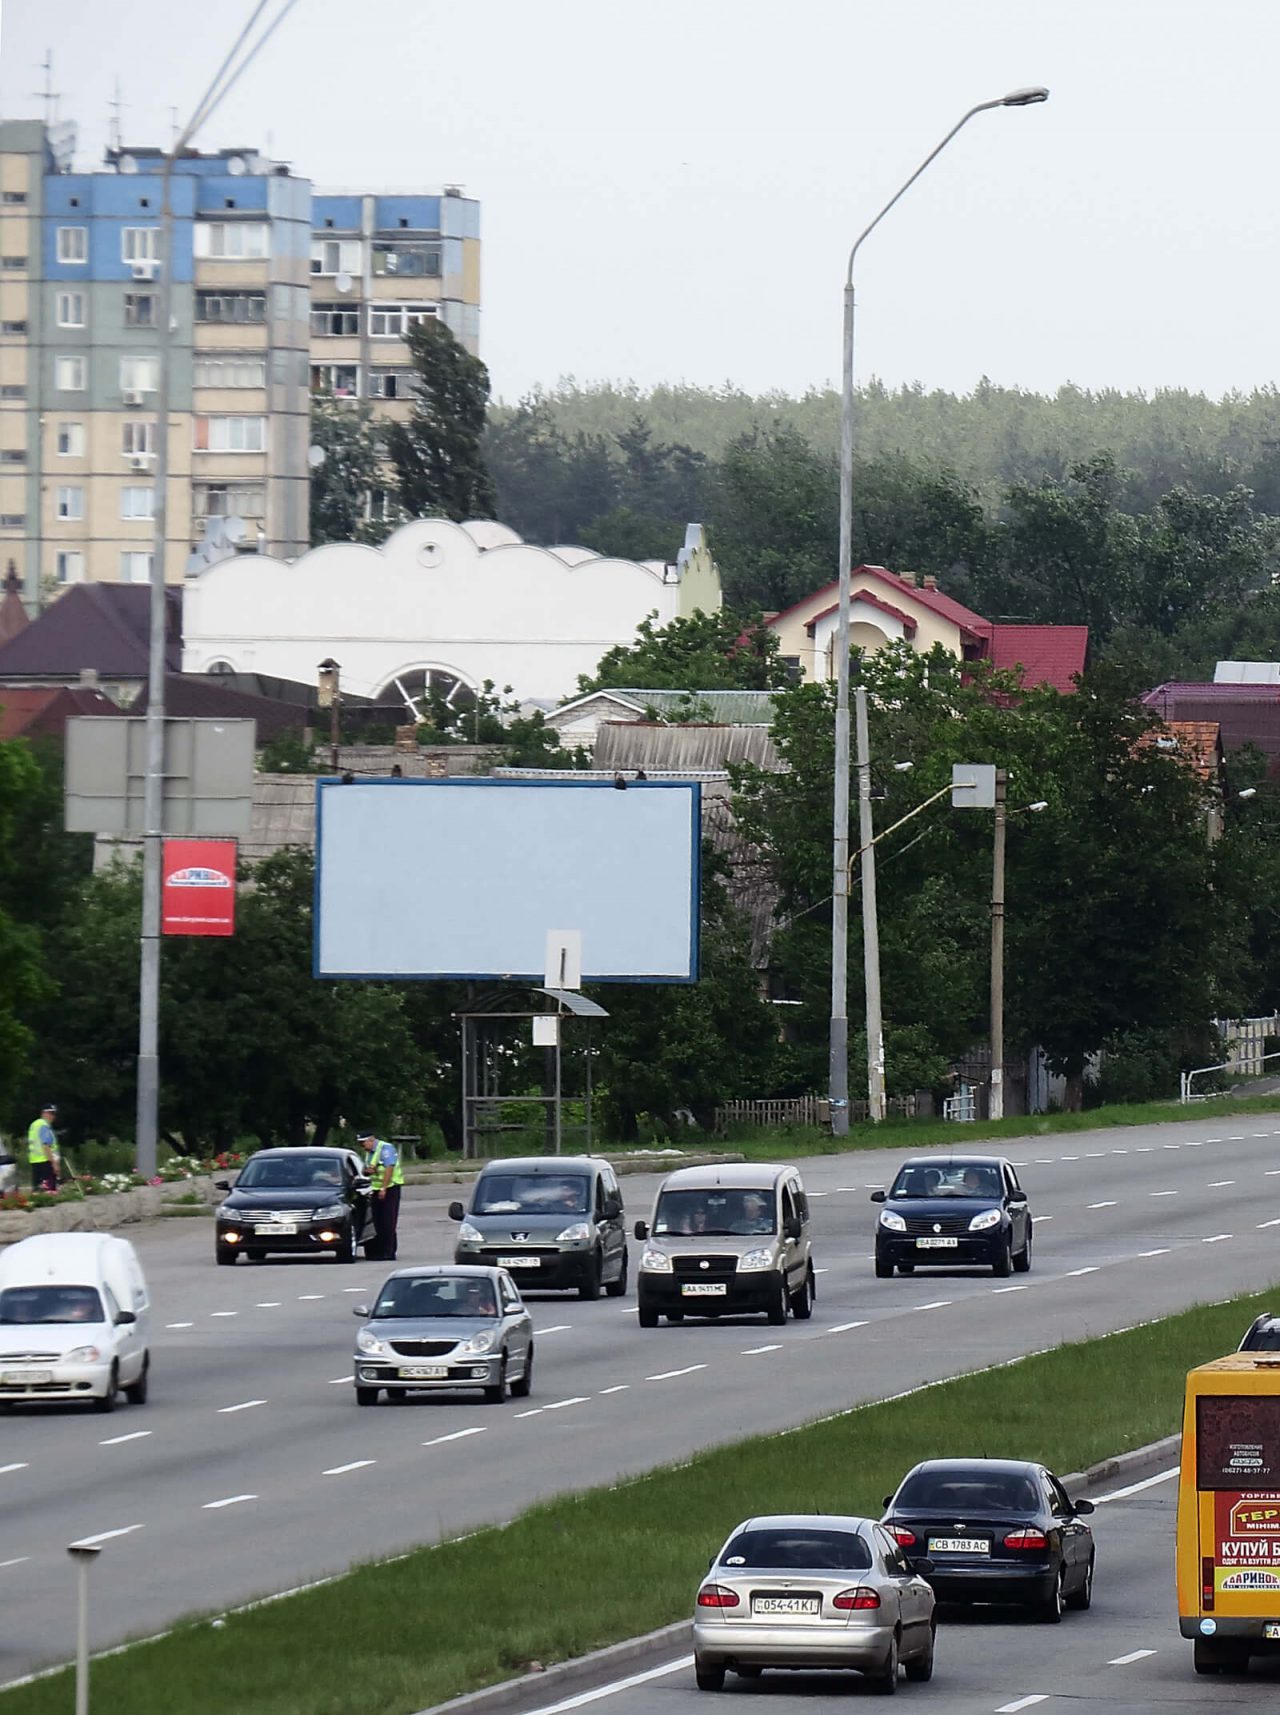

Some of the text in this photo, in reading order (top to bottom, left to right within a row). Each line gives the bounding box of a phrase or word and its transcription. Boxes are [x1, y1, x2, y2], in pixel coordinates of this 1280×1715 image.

[935, 1540, 986, 1550] CB 1783 AC
[1222, 1539, 1268, 1556] КУПУЙ
